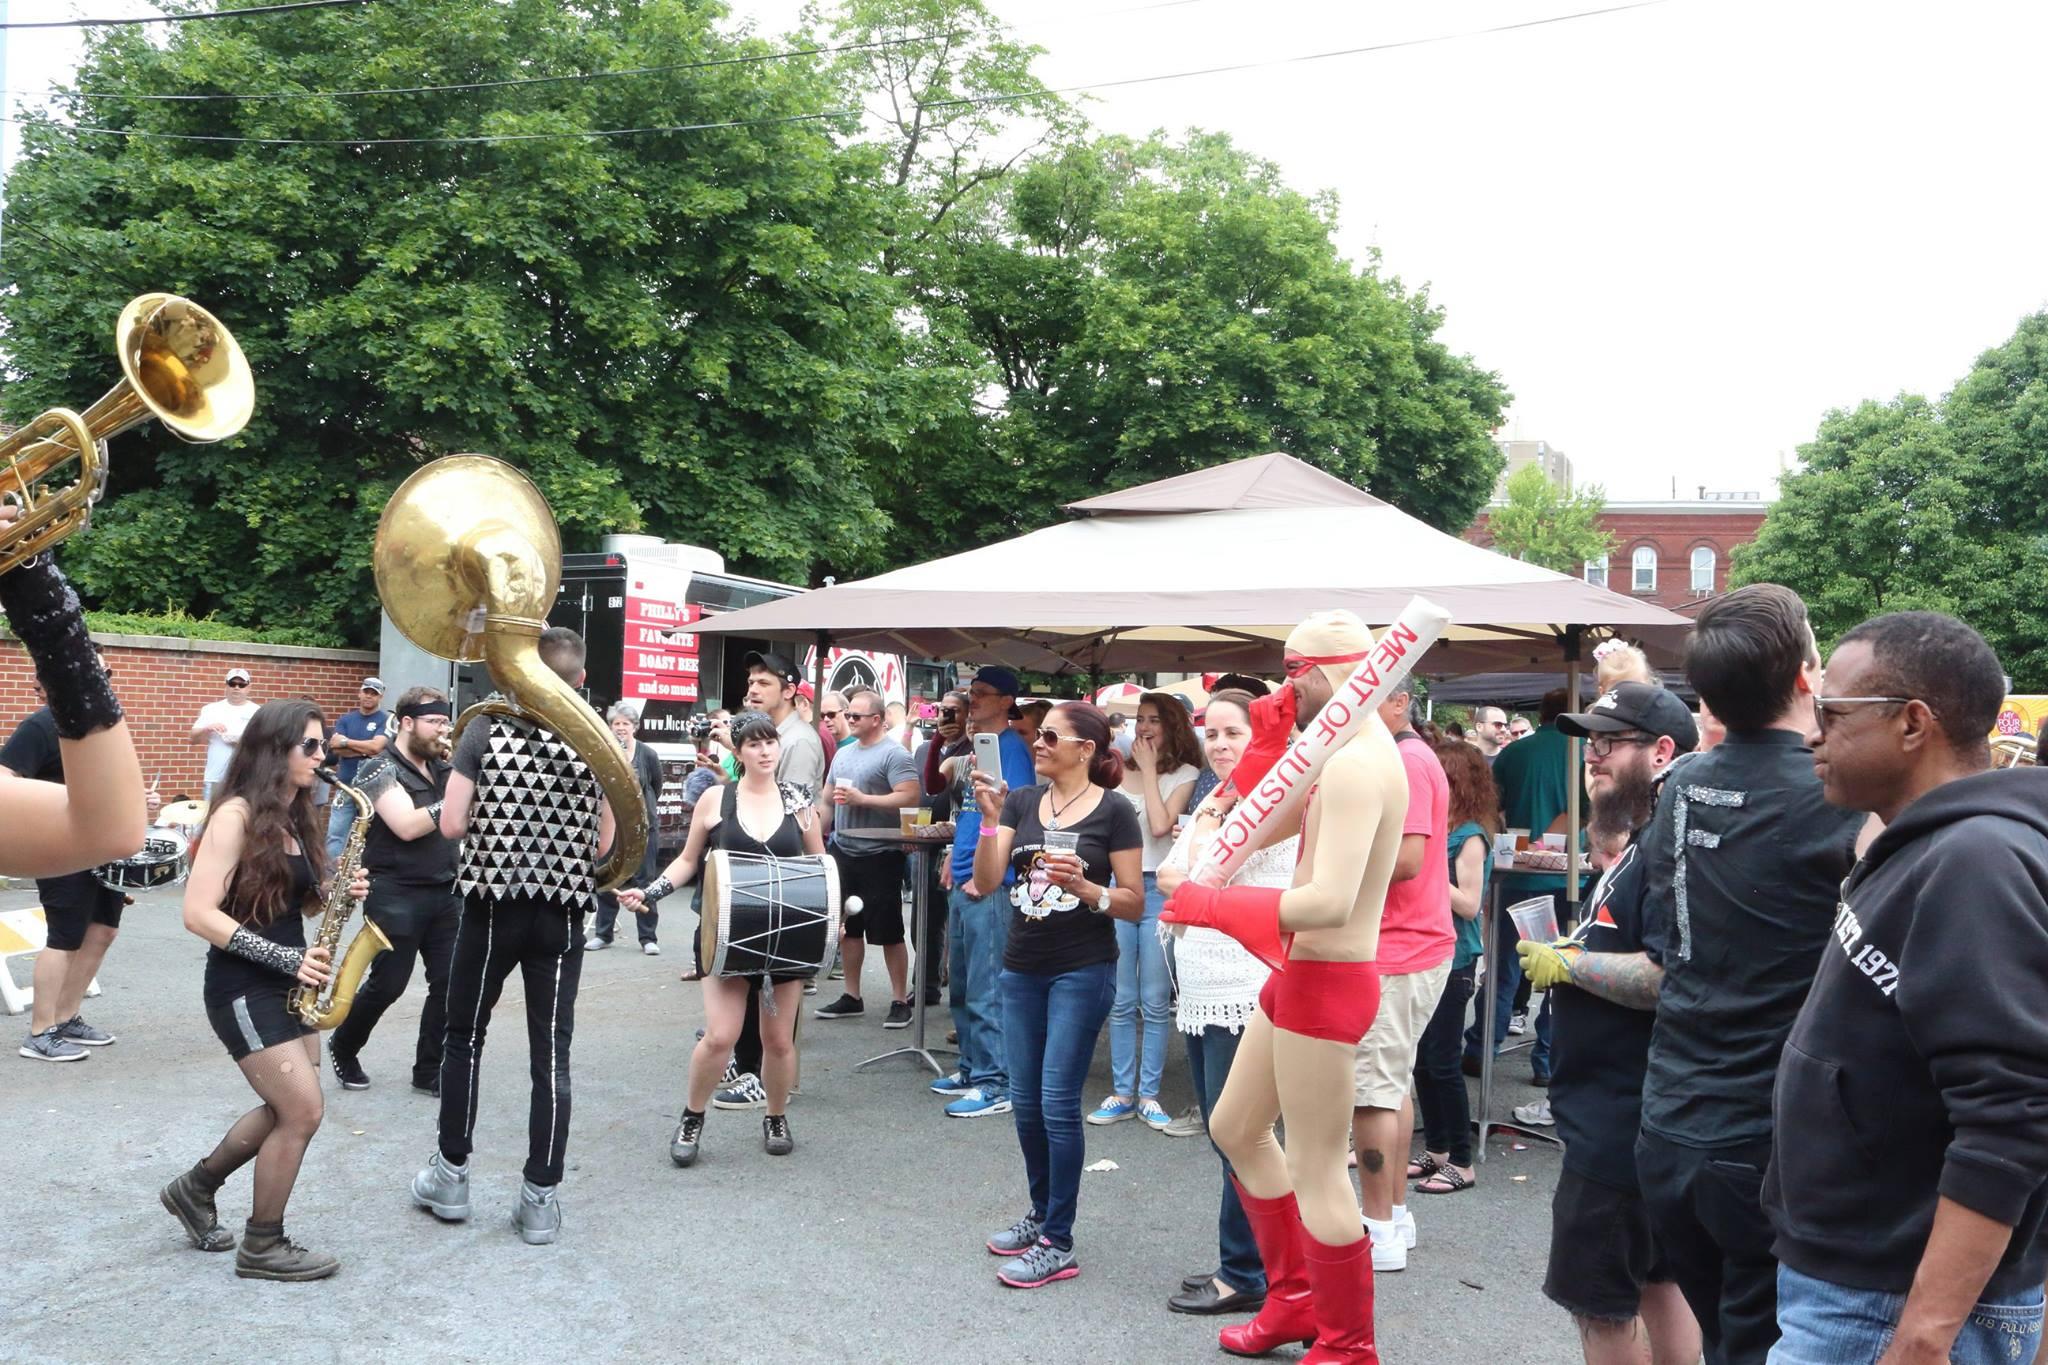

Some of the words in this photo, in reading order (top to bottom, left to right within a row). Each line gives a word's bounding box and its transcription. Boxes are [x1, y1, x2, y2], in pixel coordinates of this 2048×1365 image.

[640, 602, 690, 622] PHILLY'S
[638, 653, 676, 670] ROAST
[1348, 621, 1418, 708] MEAT
[638, 680, 658, 694] and
[658, 683, 670, 694] so
[670, 683, 698, 697] much
[1316, 700, 1351, 747] OF
[1998, 719, 2021, 727] FOUR
[2003, 711, 2015, 720] MY
[1999, 726, 2020, 734] SUNS
[1212, 740, 1312, 866] JUSTICE
